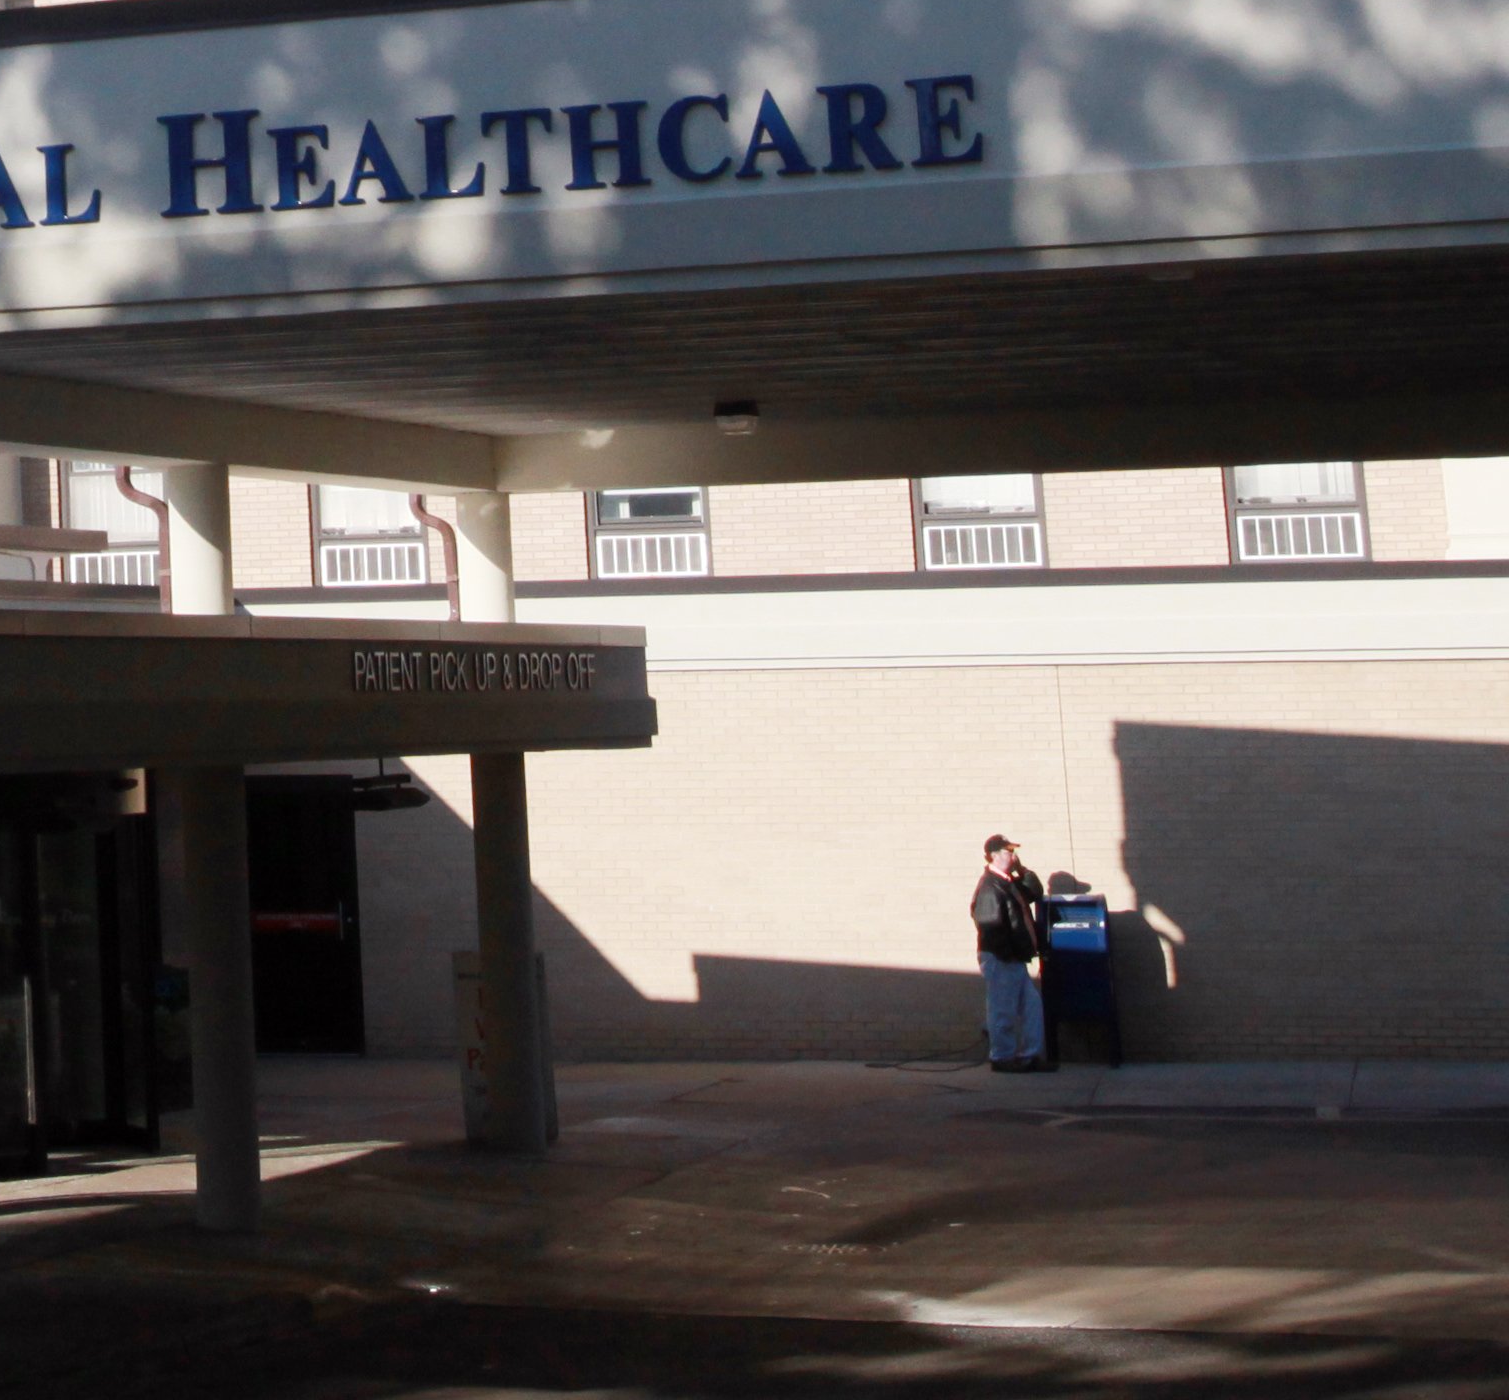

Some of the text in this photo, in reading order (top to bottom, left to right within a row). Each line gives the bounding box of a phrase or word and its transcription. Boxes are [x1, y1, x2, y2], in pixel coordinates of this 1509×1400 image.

[156, 74, 983, 219] HEALTHCARE
[354, 651, 596, 691] PATIENT PICK UP & DROP OFF
